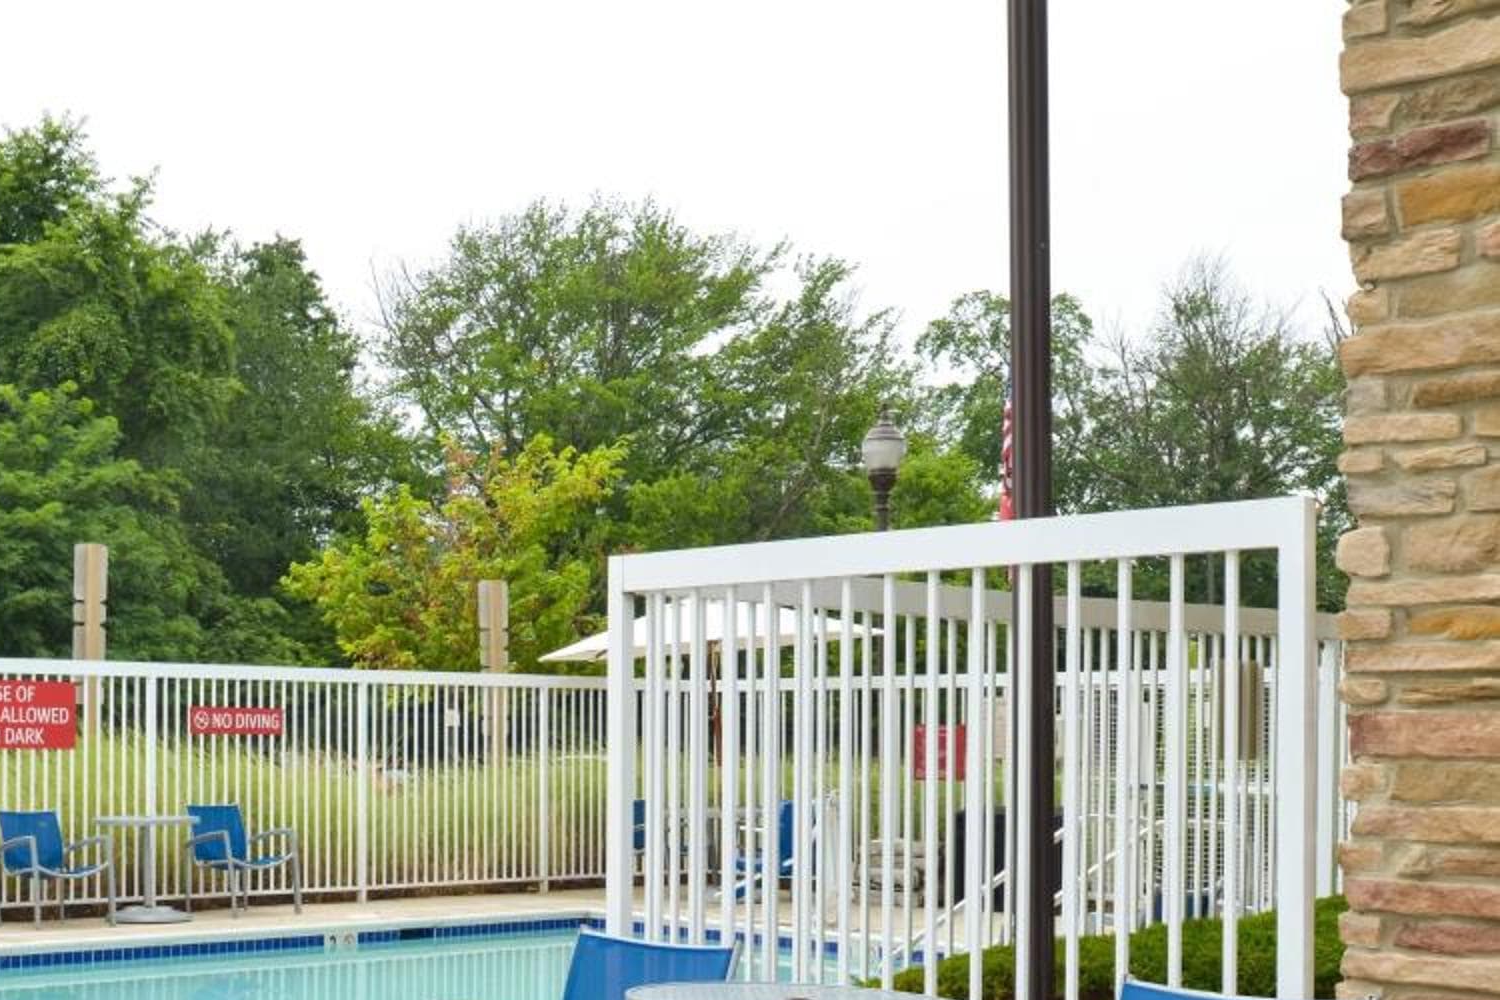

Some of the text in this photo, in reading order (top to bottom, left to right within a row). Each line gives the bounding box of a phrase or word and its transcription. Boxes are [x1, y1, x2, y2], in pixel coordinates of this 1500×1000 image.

[15, 686, 36, 702] OF
[0, 706, 69, 724] ALLOWED
[212, 713, 280, 729] NO DIVING
[5, 728, 45, 744] DARK
